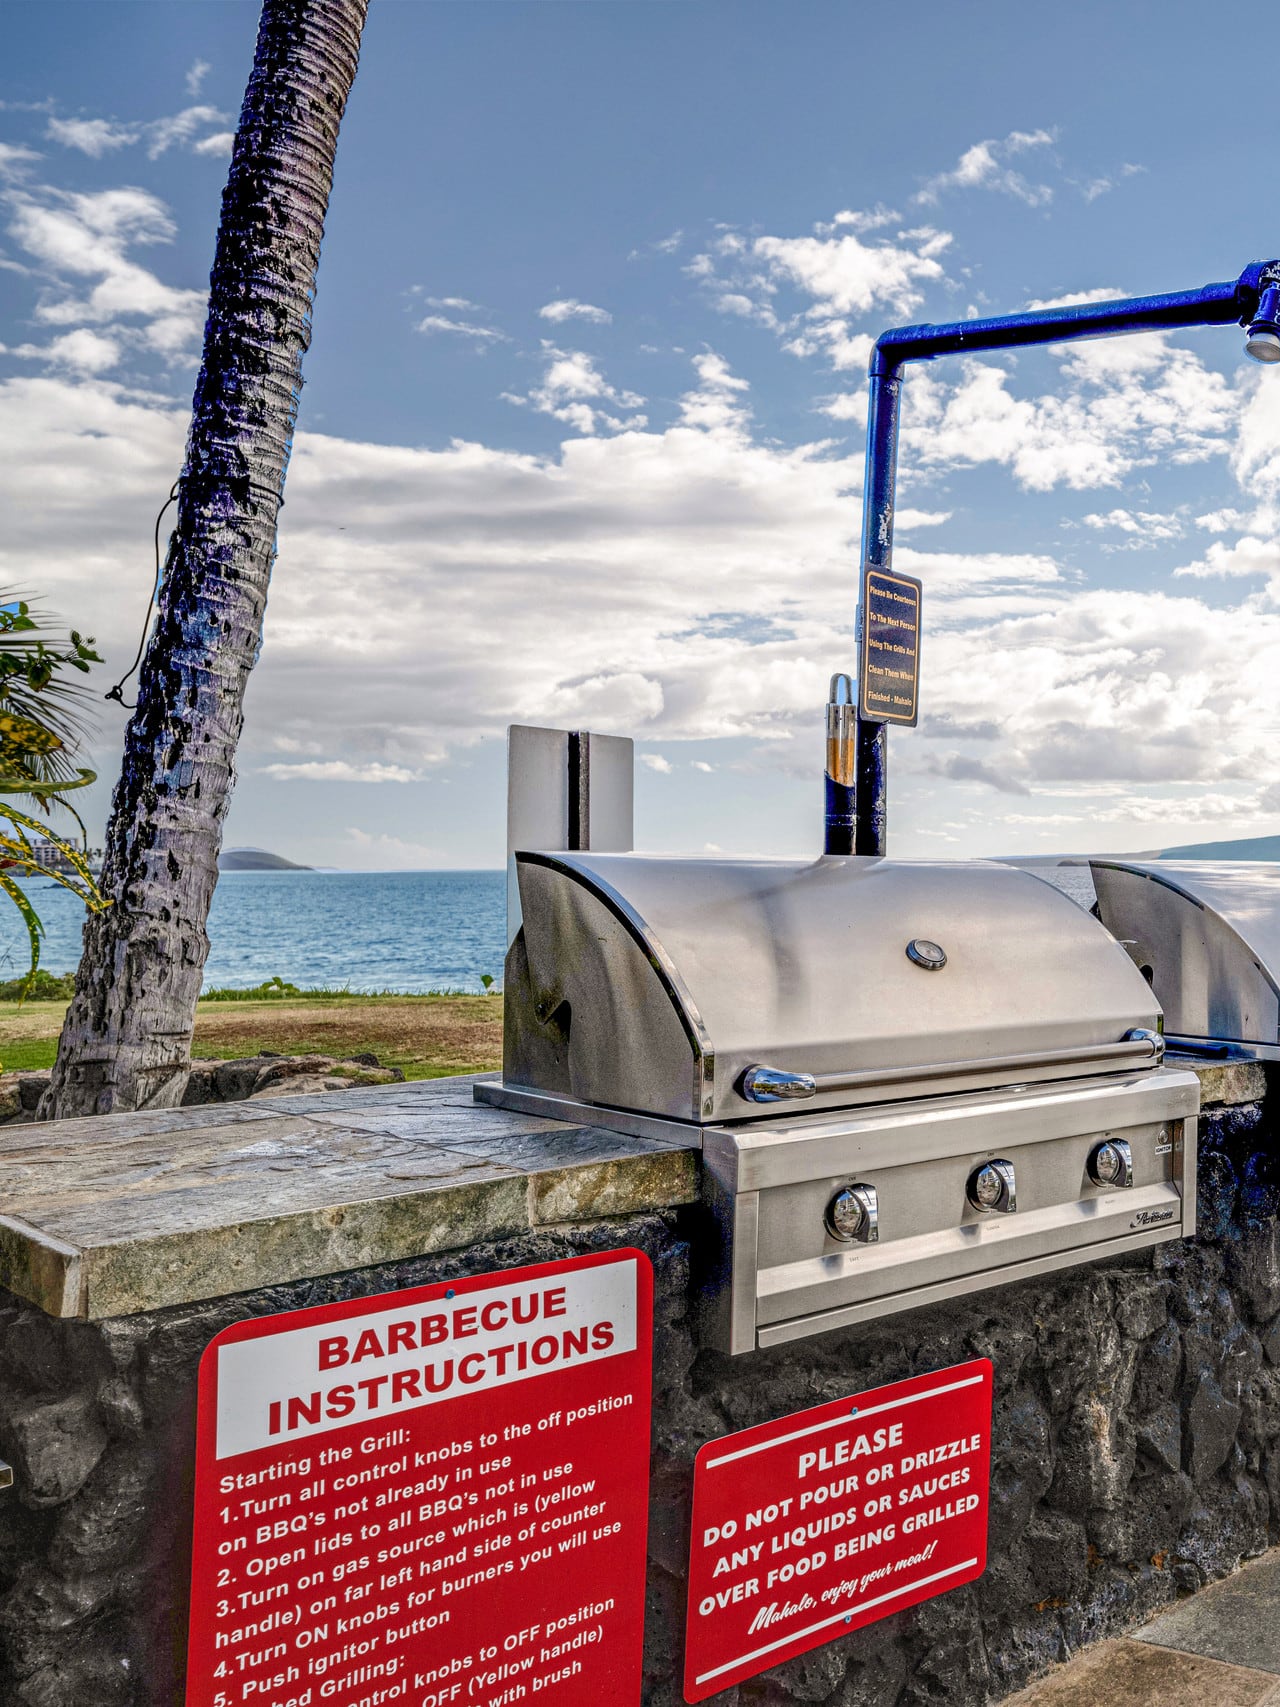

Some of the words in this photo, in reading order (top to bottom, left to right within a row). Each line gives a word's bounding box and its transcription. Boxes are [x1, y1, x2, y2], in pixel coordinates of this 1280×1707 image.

[869, 587, 886, 598] Please
[886, 591, 893, 600] Be
[869, 612, 877, 621] To
[877, 613, 887, 624] The
[887, 616, 899, 627] Next
[899, 620, 916, 631] Person
[868, 664, 884, 676] Clean
[884, 667, 899, 678] Them
[900, 671, 914, 681] When
[869, 639, 883, 650] Using
[883, 642, 892, 651] The
[893, 645, 906, 655] Grills
[906, 648, 915, 656] And
[868, 691, 890, 702] Finished
[894, 695, 912, 706] Mahalo
[1156, 1145, 1171, 1153] IGNITOR
[318, 1287, 567, 1371] BARBECUE
[269, 1321, 614, 1435] INSTRUCTIONS
[219, 1493, 291, 1524] 1.Turn
[299, 1479, 325, 1501] all
[333, 1455, 407, 1491] control
[414, 1440, 473, 1468] knobs
[479, 1433, 498, 1448] to
[503, 1423, 532, 1441] the
[537, 1410, 562, 1431] off
[566, 1393, 633, 1426] position
[219, 1457, 311, 1494] Starting
[318, 1446, 353, 1466] the
[360, 1428, 411, 1454] Grill:
[703, 1519, 738, 1548] DO
[745, 1497, 794, 1532] NOT
[799, 1475, 860, 1511] POUR
[865, 1463, 895, 1486] OR
[900, 1433, 981, 1475] DRIZZLE
[798, 1422, 903, 1479] PLEASE
[215, 1583, 289, 1618] 3.Turn
[297, 1571, 325, 1590] on
[332, 1555, 370, 1582] gas
[376, 1530, 446, 1563] source
[451, 1507, 507, 1538] which
[513, 1502, 529, 1518] is
[534, 1479, 596, 1513] (yellow
[216, 1568, 237, 1588] 2.
[246, 1547, 306, 1577] Open
[314, 1532, 353, 1556] lids
[360, 1524, 381, 1541] to
[387, 1509, 412, 1532] all
[419, 1491, 479, 1522] BBQ's
[485, 1478, 515, 1501] not
[520, 1473, 537, 1489] in
[543, 1462, 573, 1481] use
[217, 1536, 247, 1556] on
[256, 1511, 326, 1545] BBQ's
[334, 1496, 369, 1521] not
[375, 1474, 449, 1508] already
[455, 1467, 473, 1483] in
[479, 1455, 512, 1475] use
[712, 1541, 765, 1579] ANY
[771, 1506, 857, 1554] LIQUIDS
[863, 1494, 893, 1518] OR
[898, 1466, 971, 1506] SAUCES
[213, 1642, 287, 1678] 4.Turn
[295, 1623, 329, 1649] ON
[336, 1601, 400, 1635] knobs
[406, 1588, 436, 1609] for
[441, 1560, 514, 1597] burners
[519, 1545, 552, 1572] you
[557, 1530, 587, 1553] will
[592, 1521, 622, 1541] use
[215, 1604, 302, 1650] handle)
[309, 1595, 337, 1615] on
[343, 1582, 374, 1603] far
[380, 1566, 413, 1591] left
[419, 1546, 467, 1577] hand
[473, 1534, 512, 1557] side
[517, 1521, 537, 1542] of
[540, 1501, 607, 1533] counter
[698, 1577, 760, 1616] OVER
[766, 1551, 827, 1589] FOOD
[833, 1523, 896, 1562] BEING
[901, 1493, 980, 1534] GRILLED
[747, 1592, 818, 1635] Mahalo,
[820, 1578, 859, 1605] enjoy
[859, 1562, 894, 1593] your
[893, 1539, 939, 1572] meal!
[213, 1691, 233, 1707] 5.
[242, 1665, 300, 1700] Push
[308, 1636, 380, 1676] ignitor
[385, 1610, 450, 1645] button
[319, 1655, 405, 1698] Grilling:
[414, 1655, 473, 1689] knobs
[479, 1645, 498, 1662] to
[503, 1624, 541, 1651] OFF
[545, 1598, 615, 1639] position
[421, 1682, 462, 1707] OFF
[468, 1655, 535, 1697] (Yellow
[540, 1624, 603, 1663] handle)
[488, 1684, 526, 1707] with
[532, 1660, 582, 1692] brush
